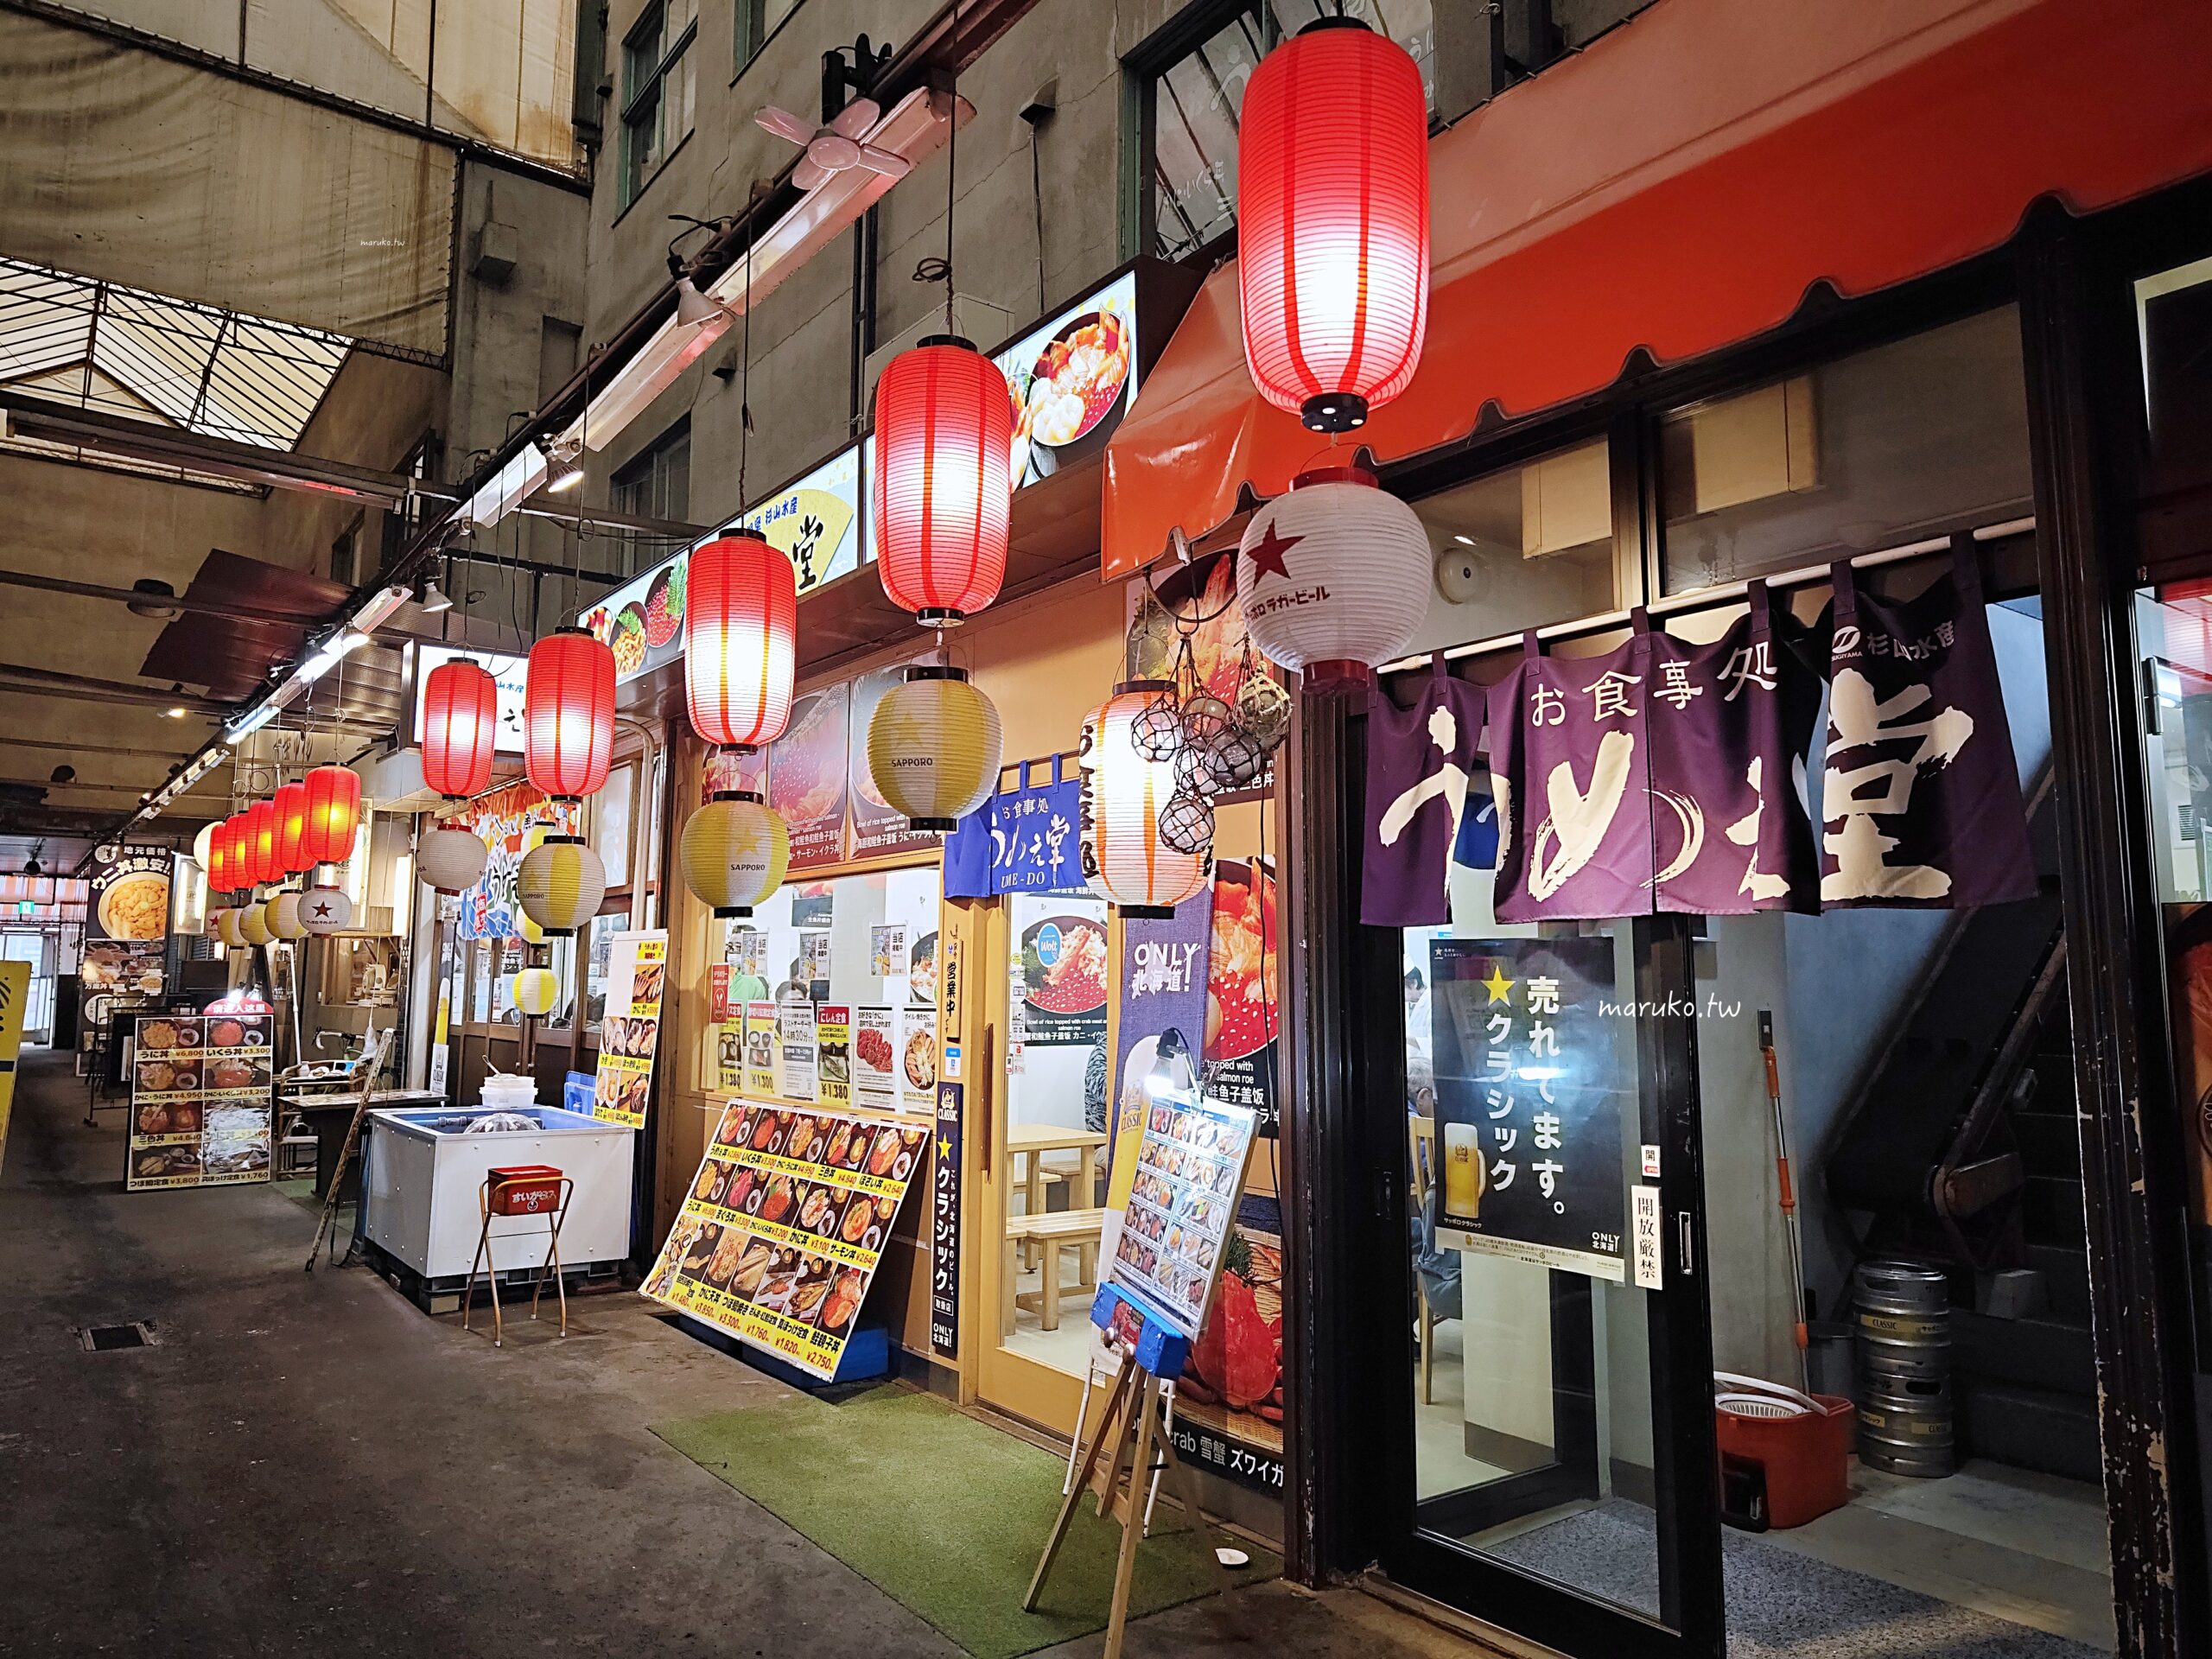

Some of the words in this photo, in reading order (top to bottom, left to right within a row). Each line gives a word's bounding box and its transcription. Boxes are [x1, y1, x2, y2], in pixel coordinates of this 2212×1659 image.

[766, 497, 798, 525] 杉山水産
[1831, 651, 1864, 662] SUGIYAMA
[1530, 641, 1778, 728] お食事処
[892, 757, 933, 768] SAPPORO
[880, 815, 896, 824] topped
[124, 846, 167, 856] 地元価格
[730, 863, 766, 872] SAPPORO
[1040, 940, 1058, 952] Wolt
[1134, 943, 1198, 967] ONLY
[821, 1012, 847, 1024] にしん定食
[140, 1050, 170, 1059] うに丼
[206, 1046, 243, 1057] いくら丼
[1207, 1059, 1235, 1071] topped
[1236, 1060, 1254, 1071] with
[1216, 1071, 1241, 1084] salmon
[1242, 1075, 1255, 1084] roe
[174, 1091, 204, 1100] ¥4,950
[1207, 1084, 1264, 1106] 鲑鱼子盖饭
[1526, 976, 1566, 1216] 売れてます。
[1485, 1014, 1517, 1192] クラシック
[938, 1107, 958, 1122] CLASSIC
[138, 1134, 166, 1142] 三色丼
[741, 1153, 762, 1164] いくら丼
[1645, 1149, 1656, 1161] 開
[170, 1176, 200, 1185] ¥3,800
[818, 1166, 836, 1179] 三色丼
[837, 1173, 857, 1184] ¥4,840
[883, 1183, 905, 1195] ¥2,640
[687, 1200, 702, 1212] うに丼
[715, 1209, 736, 1223] まぐろ丼
[1443, 1217, 1483, 1229] サッポロクラシック
[771, 1228, 789, 1239] ¥3,200
[935, 1166, 950, 1291] クラシック
[789, 1231, 810, 1246] かに丼
[810, 1239, 830, 1252] ¥3,100
[1592, 1231, 1620, 1244] ONLY
[1637, 1196, 1656, 1280] 開放厳禁
[830, 1243, 856, 1262] サーモン丼
[855, 1251, 877, 1266] ¥2,640
[698, 1287, 721, 1305] かに天丼
[695, 1302, 714, 1318] ¥3,850
[936, 1298, 951, 1313] 取扱店
[719, 1313, 740, 1329] ¥3,300
[1872, 1319, 1897, 1331] CLASSIC
[746, 1324, 768, 1341] ¥1,760
[933, 1323, 953, 1337] ONLY
[775, 1337, 798, 1356] ¥1,820
[810, 1330, 842, 1355] 鮭親子丼
[806, 1351, 832, 1370] ¥2,750
[1169, 1431, 1197, 1453] crab
[1199, 1435, 1226, 1466] 雪蟹
[1230, 1448, 1285, 1488] ズワイガ
